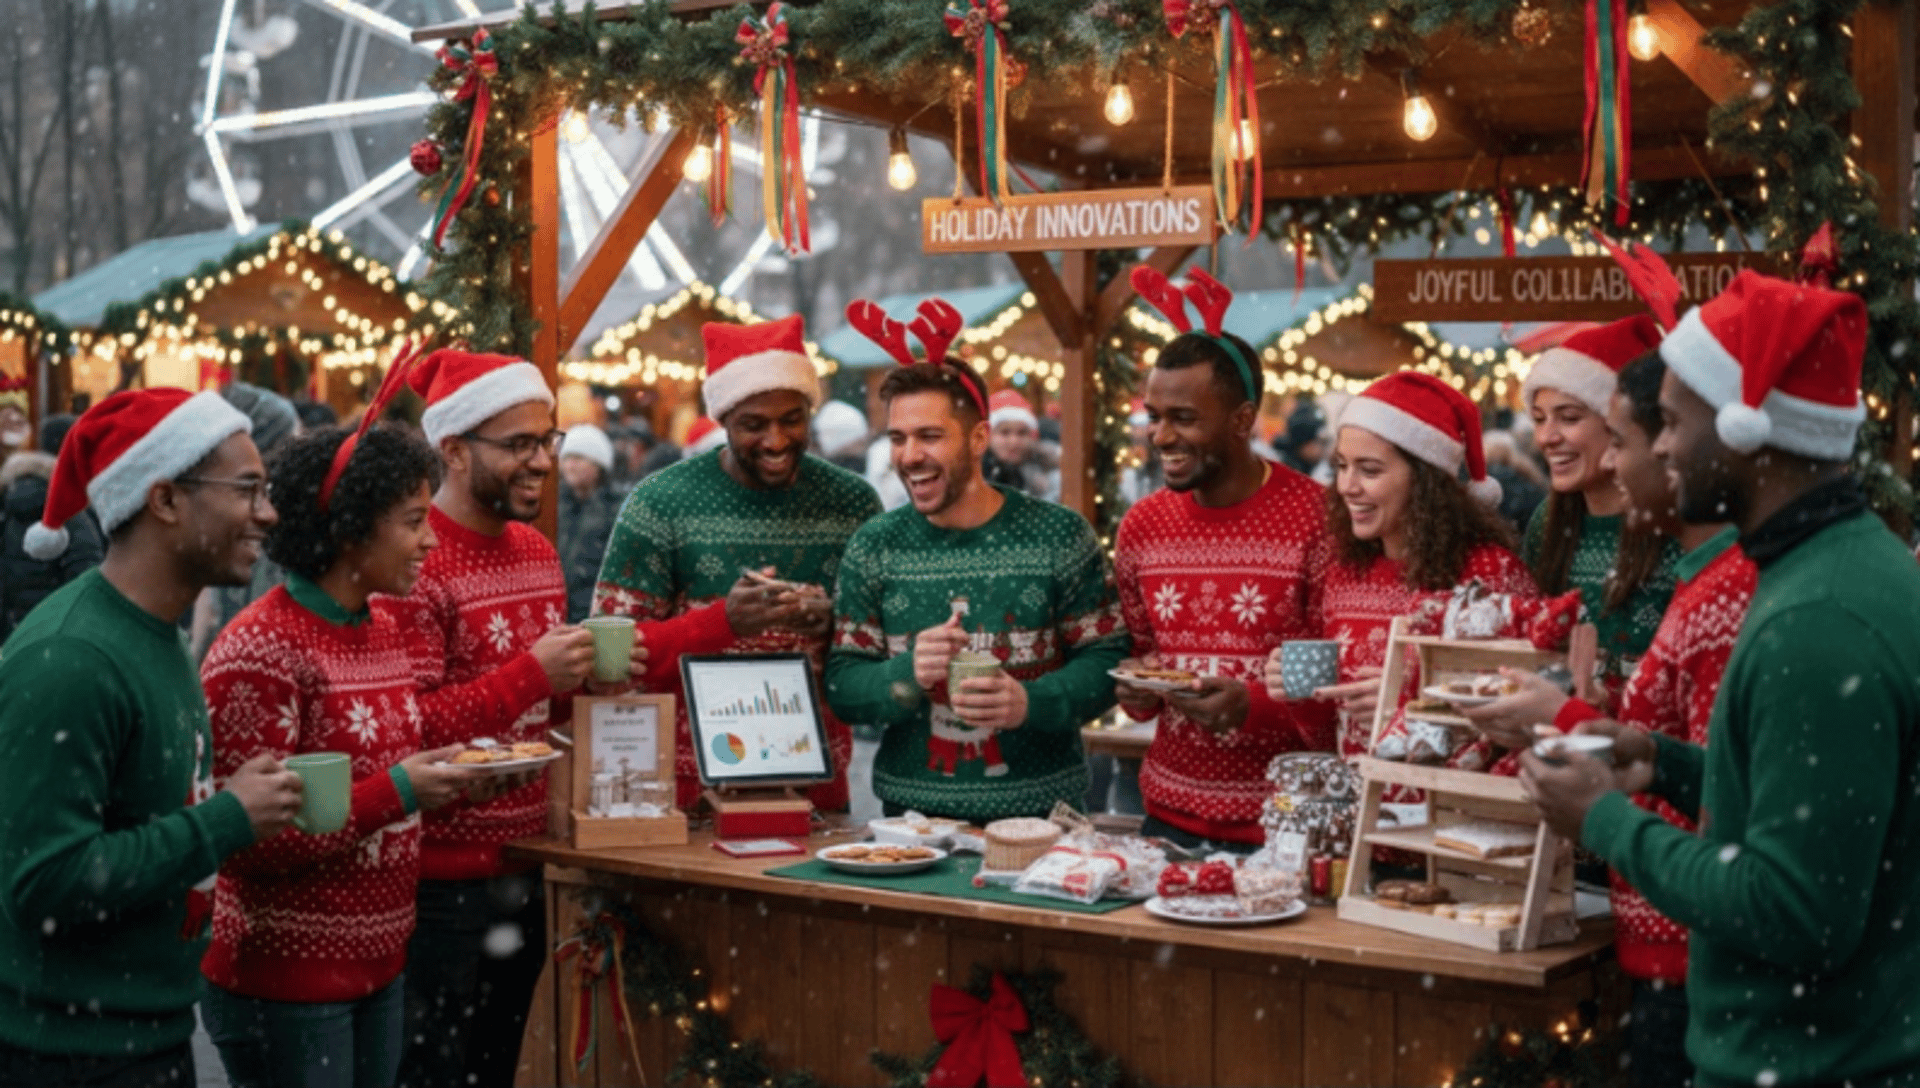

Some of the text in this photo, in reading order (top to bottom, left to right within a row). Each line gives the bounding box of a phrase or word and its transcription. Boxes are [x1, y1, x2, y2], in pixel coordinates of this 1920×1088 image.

[930, 199, 1201, 242] HOLIDAY INNOVATIONS
[1409, 269, 1501, 303] JOYFUL
